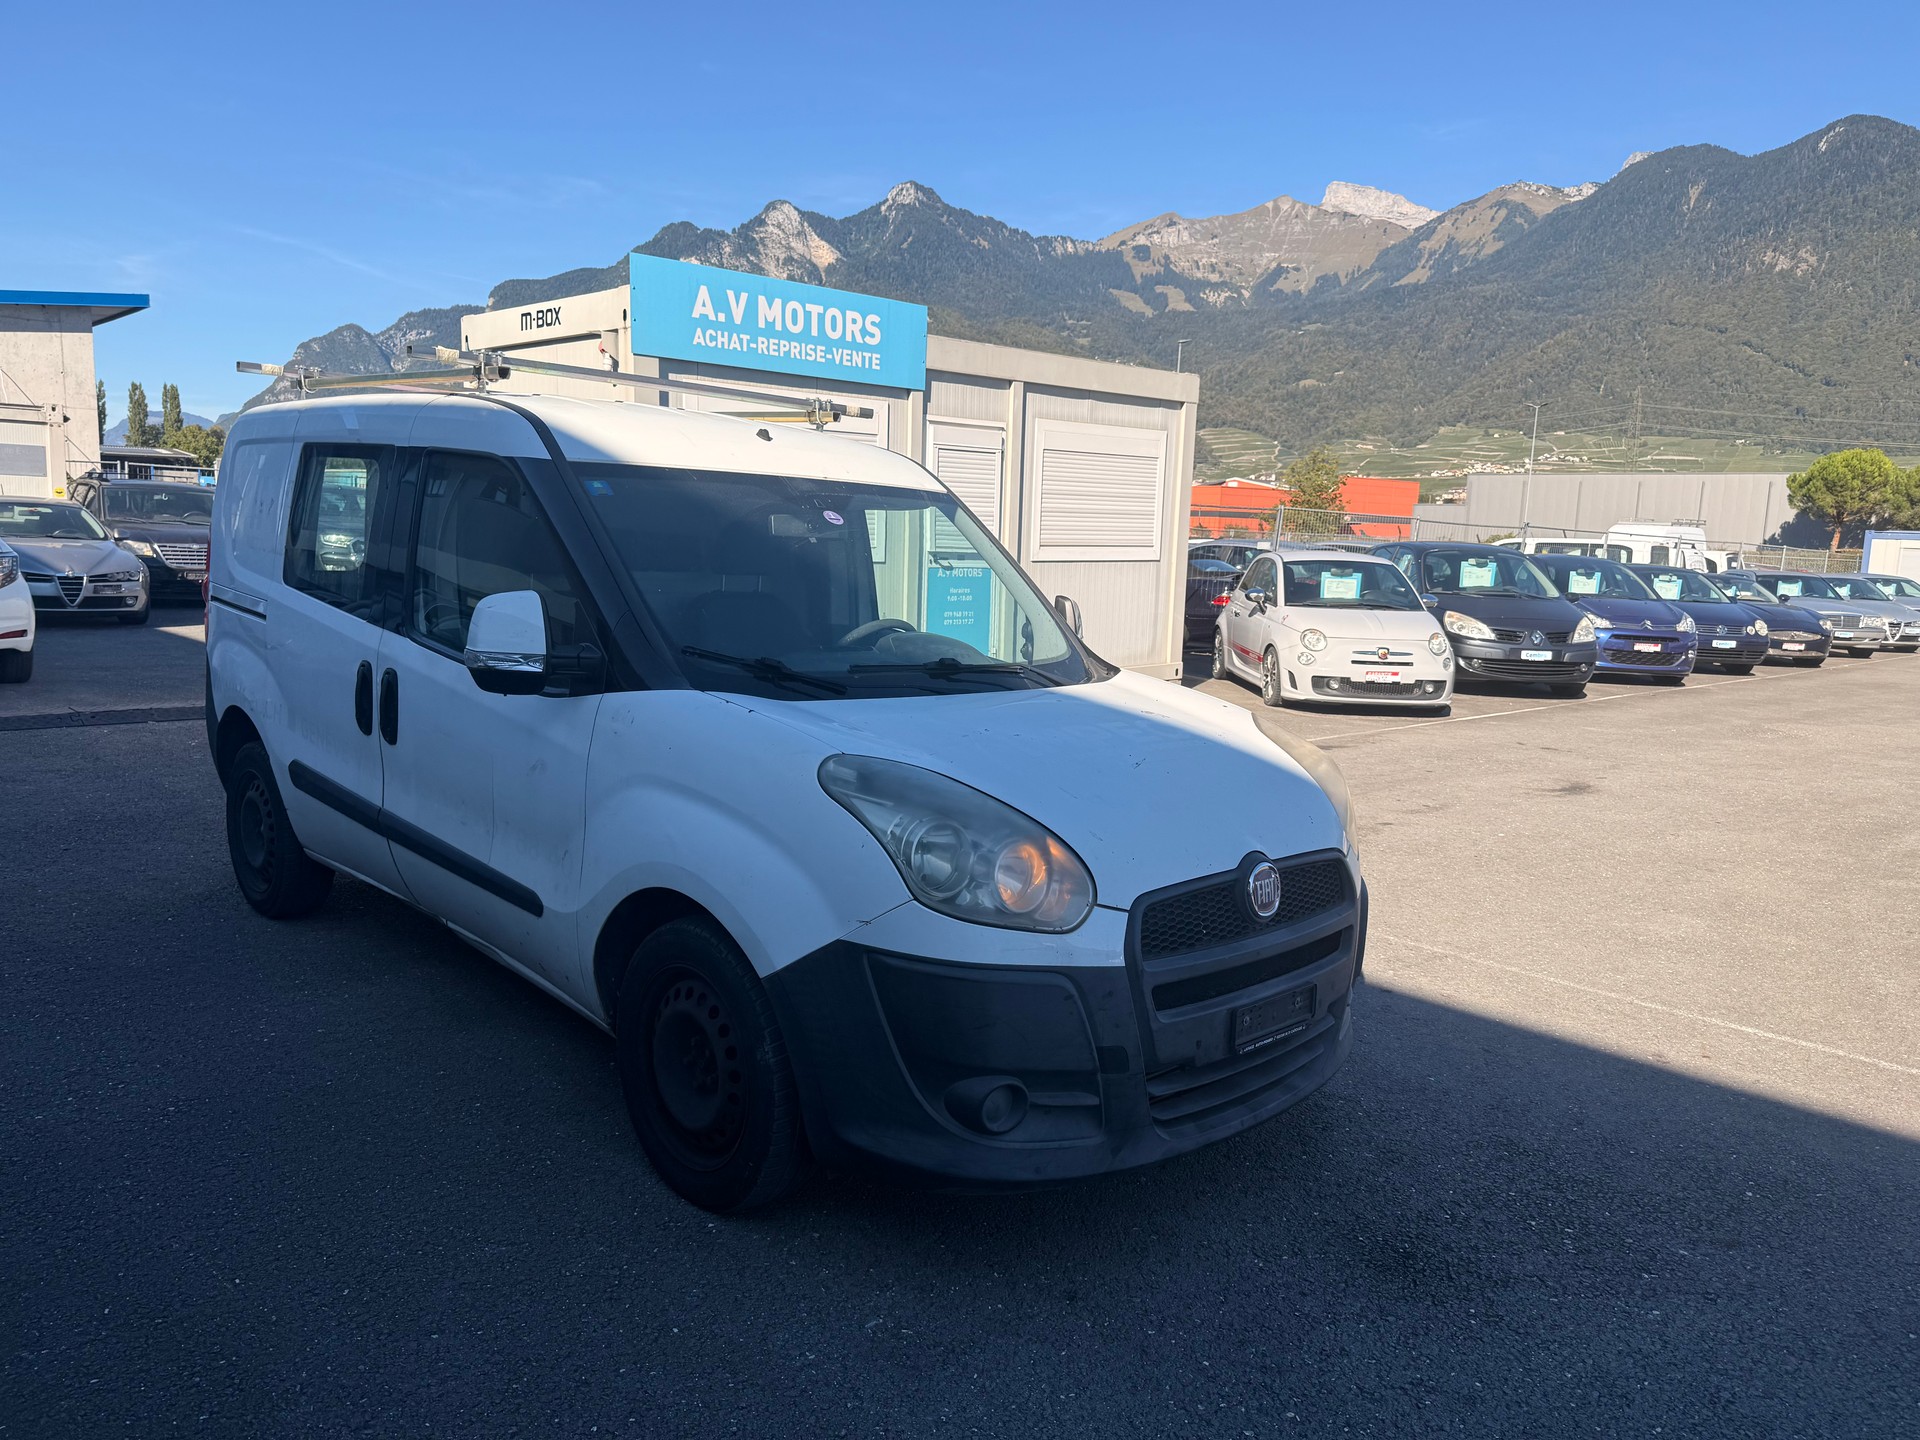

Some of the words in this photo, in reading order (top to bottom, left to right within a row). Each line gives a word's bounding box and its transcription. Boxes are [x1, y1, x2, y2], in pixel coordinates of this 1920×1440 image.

[691, 284, 749, 325] A.V
[757, 294, 882, 346] MOTORS
[692, 326, 881, 371] ACHAT-REPRISE-VENTE
[952, 568, 982, 577] MOTORS
[1256, 877, 1275, 905] FIAT
